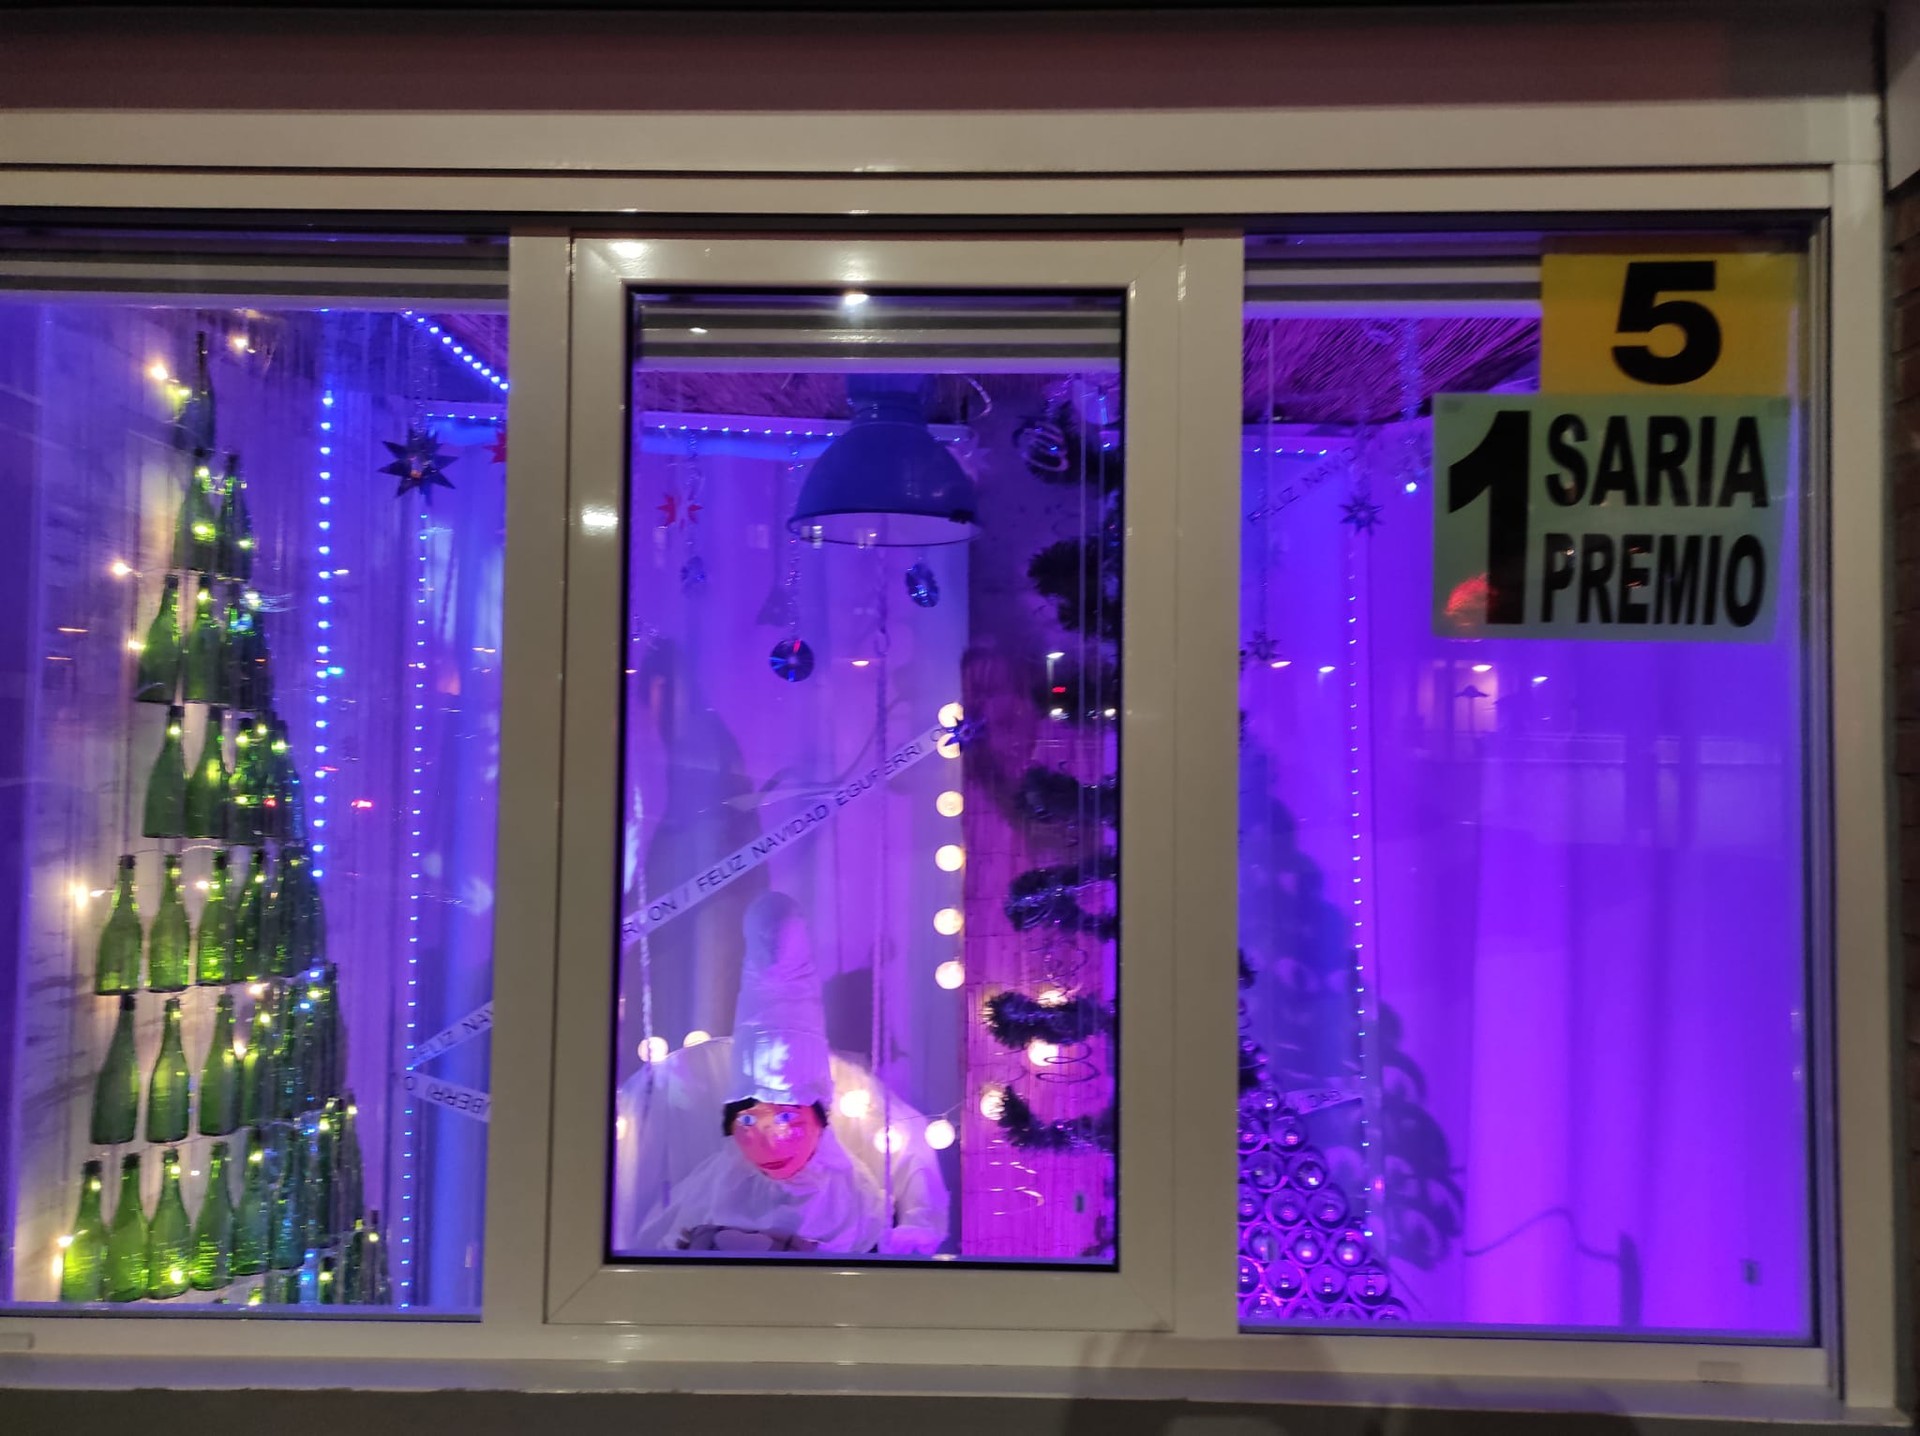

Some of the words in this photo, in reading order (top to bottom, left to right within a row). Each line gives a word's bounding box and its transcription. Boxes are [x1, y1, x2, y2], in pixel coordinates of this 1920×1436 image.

[1612, 261, 1722, 385] 5
[1546, 414, 1768, 507] SARIA
[1448, 411, 1530, 624] 1
[1541, 532, 1766, 627] PREMIO
[696, 856, 746, 892] FELIZ
[752, 804, 830, 857] NAVIDAD
